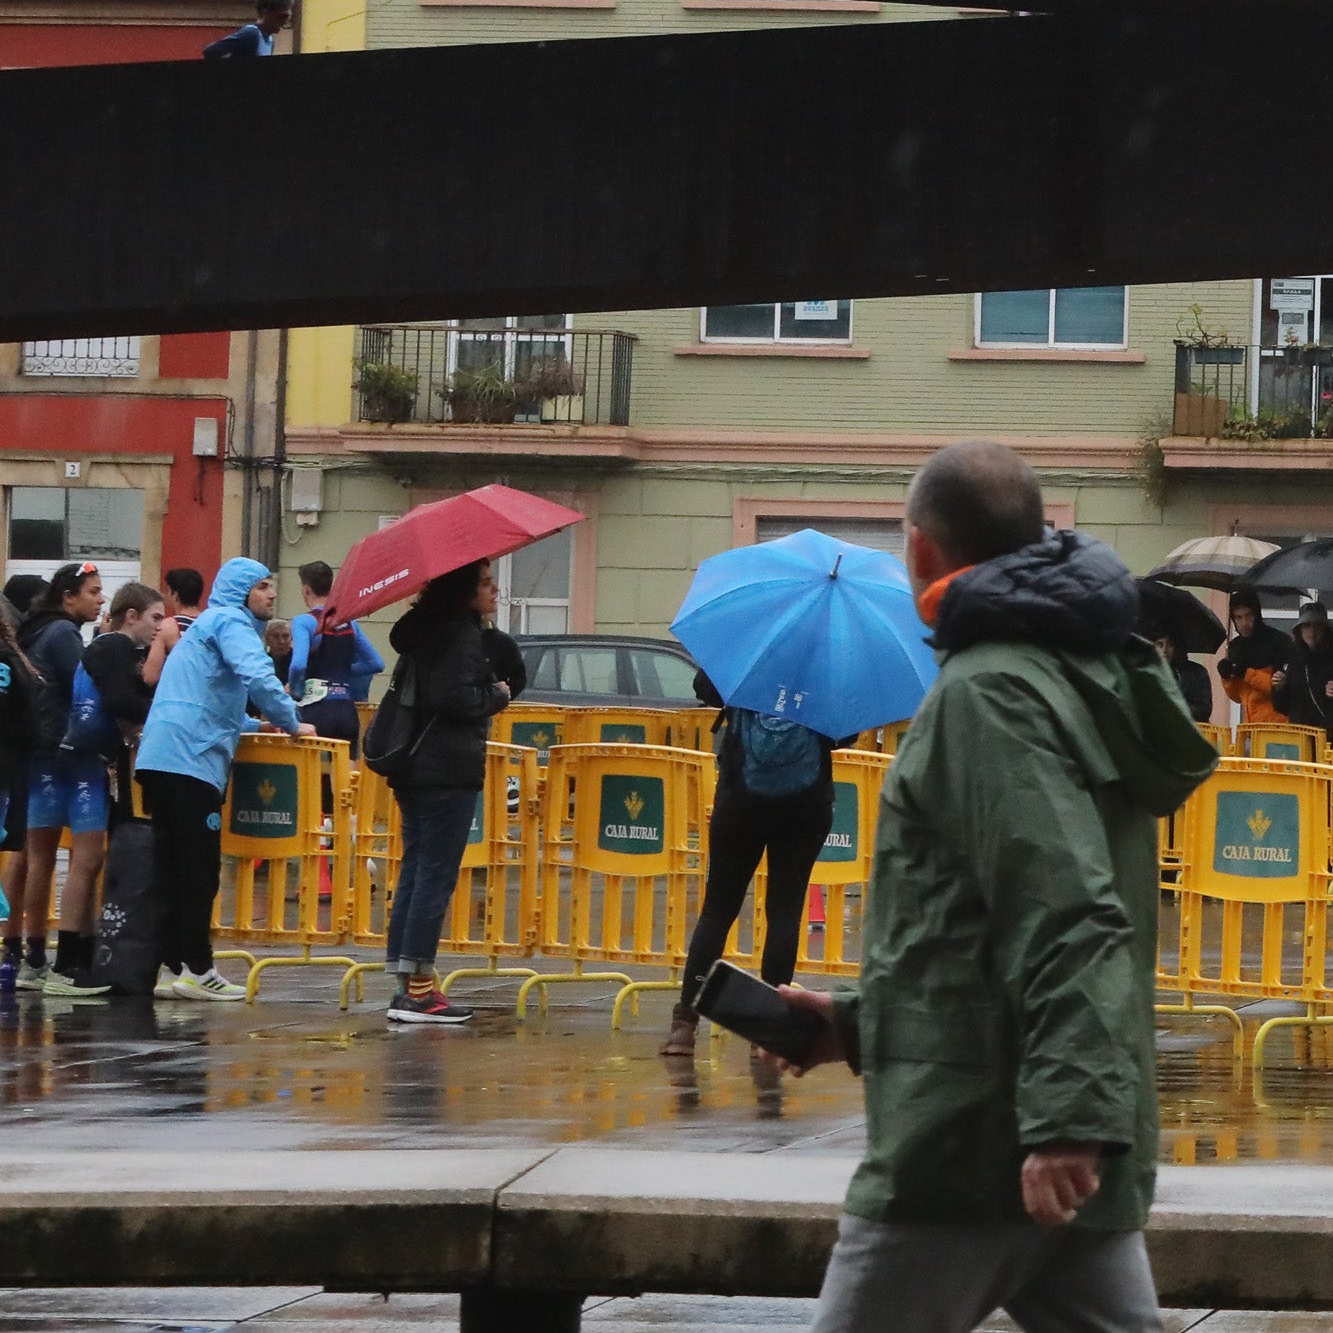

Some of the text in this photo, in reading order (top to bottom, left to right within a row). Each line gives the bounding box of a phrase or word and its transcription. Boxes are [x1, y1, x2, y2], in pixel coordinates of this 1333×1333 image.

[70, 464, 76, 475] 2
[359, 568, 410, 598] INESIS
[604, 824, 659, 841] CAJA RURAL
[1222, 845, 1292, 862] CAJA RURAL
